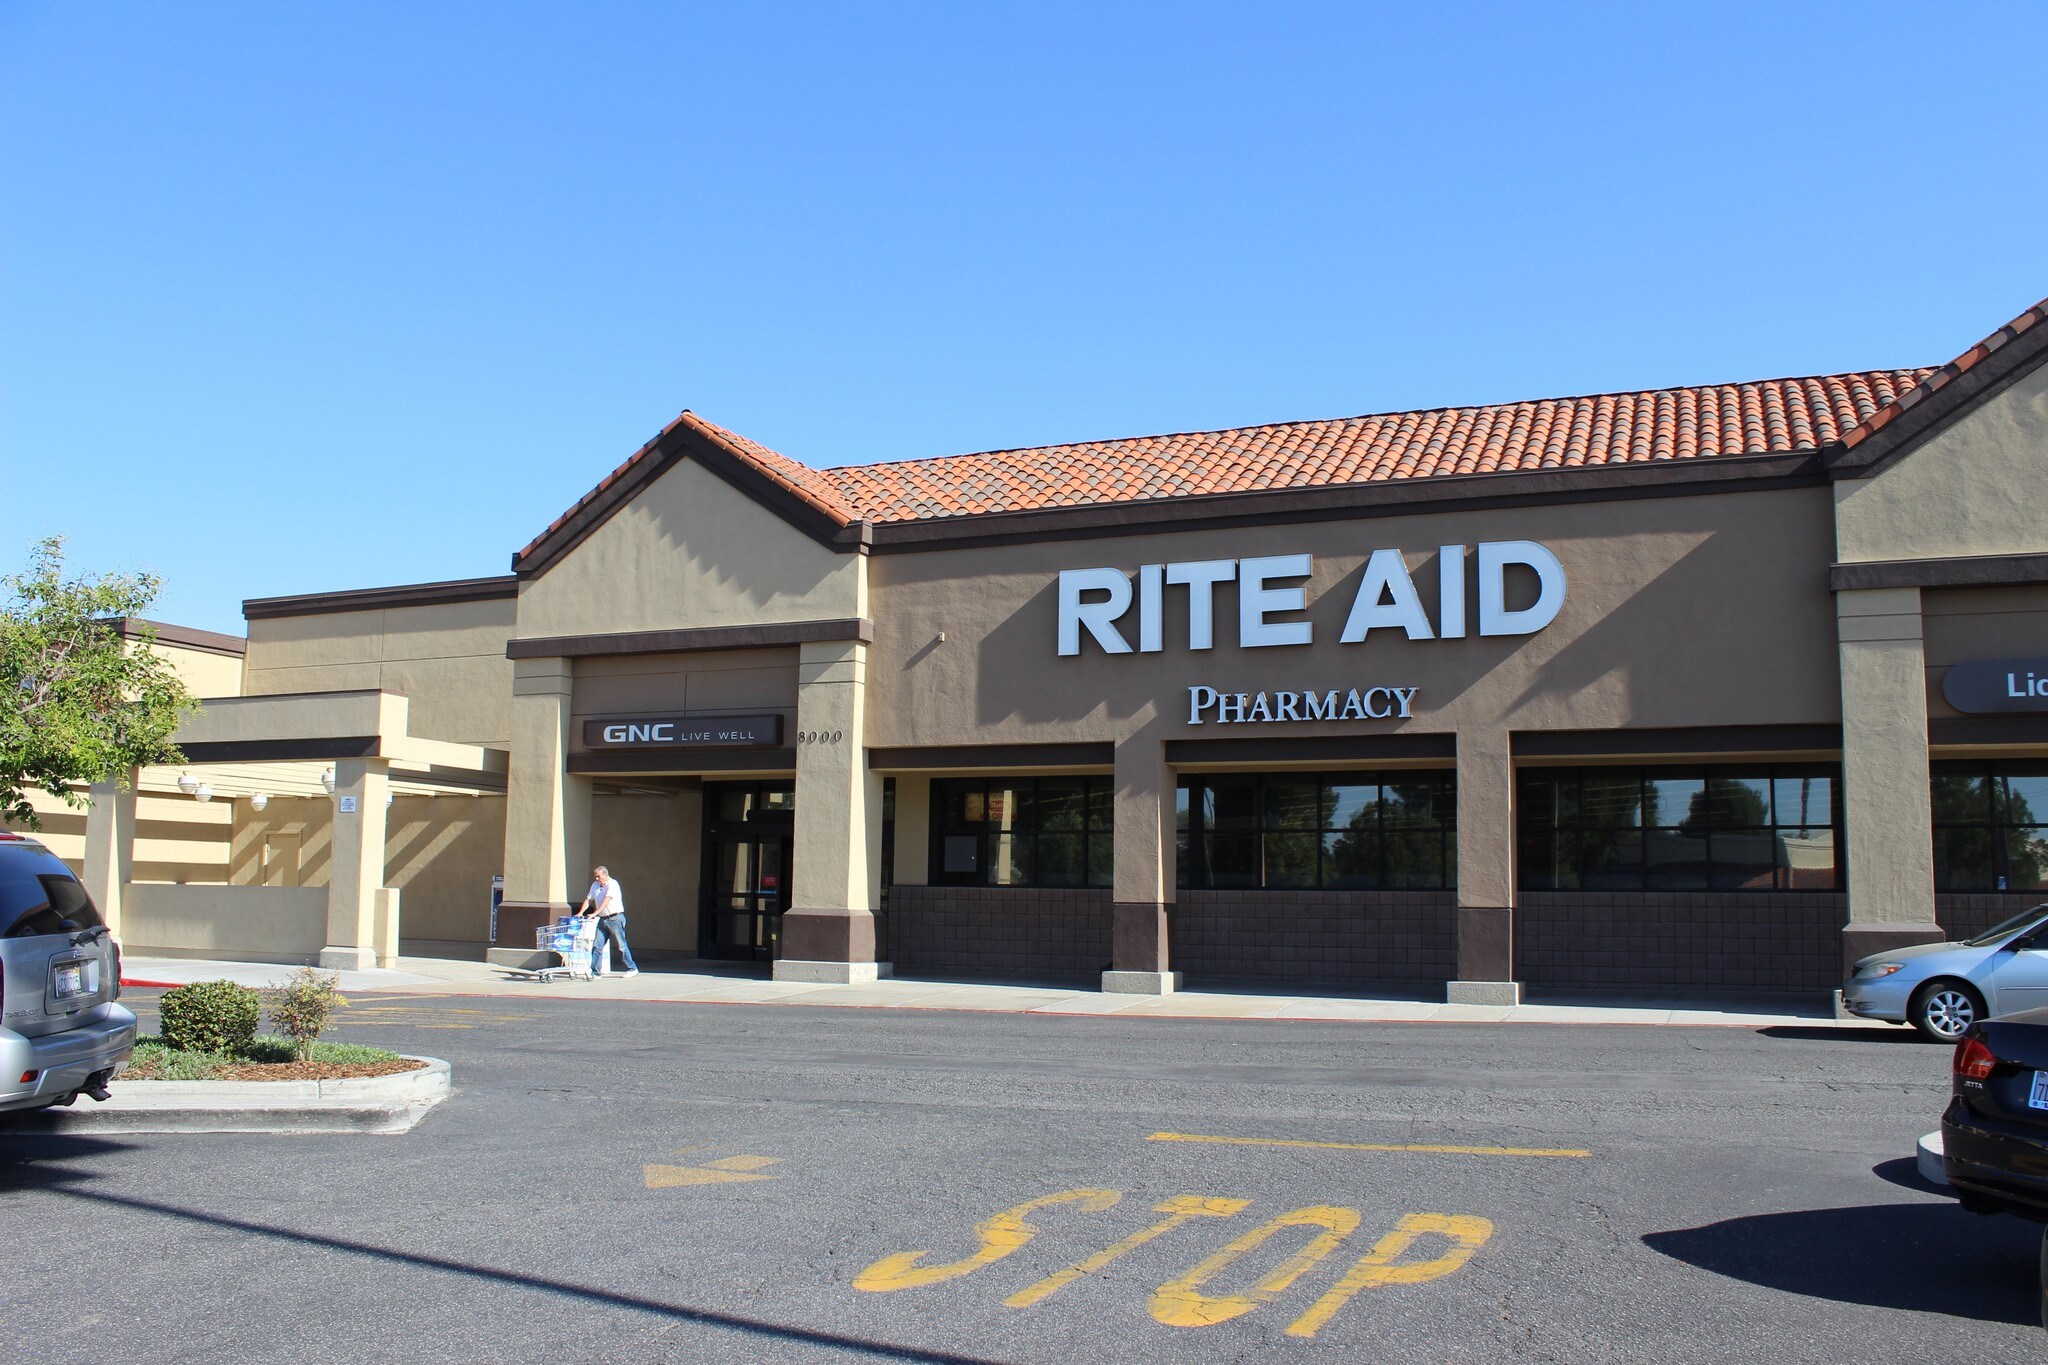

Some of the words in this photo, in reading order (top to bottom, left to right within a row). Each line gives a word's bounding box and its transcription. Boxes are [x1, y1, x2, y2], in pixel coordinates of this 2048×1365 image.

[1057, 553, 1314, 657] RITE
[1339, 540, 1568, 644] AID
[1187, 685, 1420, 726] PHARMACY
[603, 723, 675, 743] GNC
[681, 732, 711, 742] LIVE
[718, 730, 755, 741] WELL
[798, 730, 843, 743] 8000
[1963, 1080, 1984, 1090] JETTA
[851, 1187, 1494, 1338] STOP
